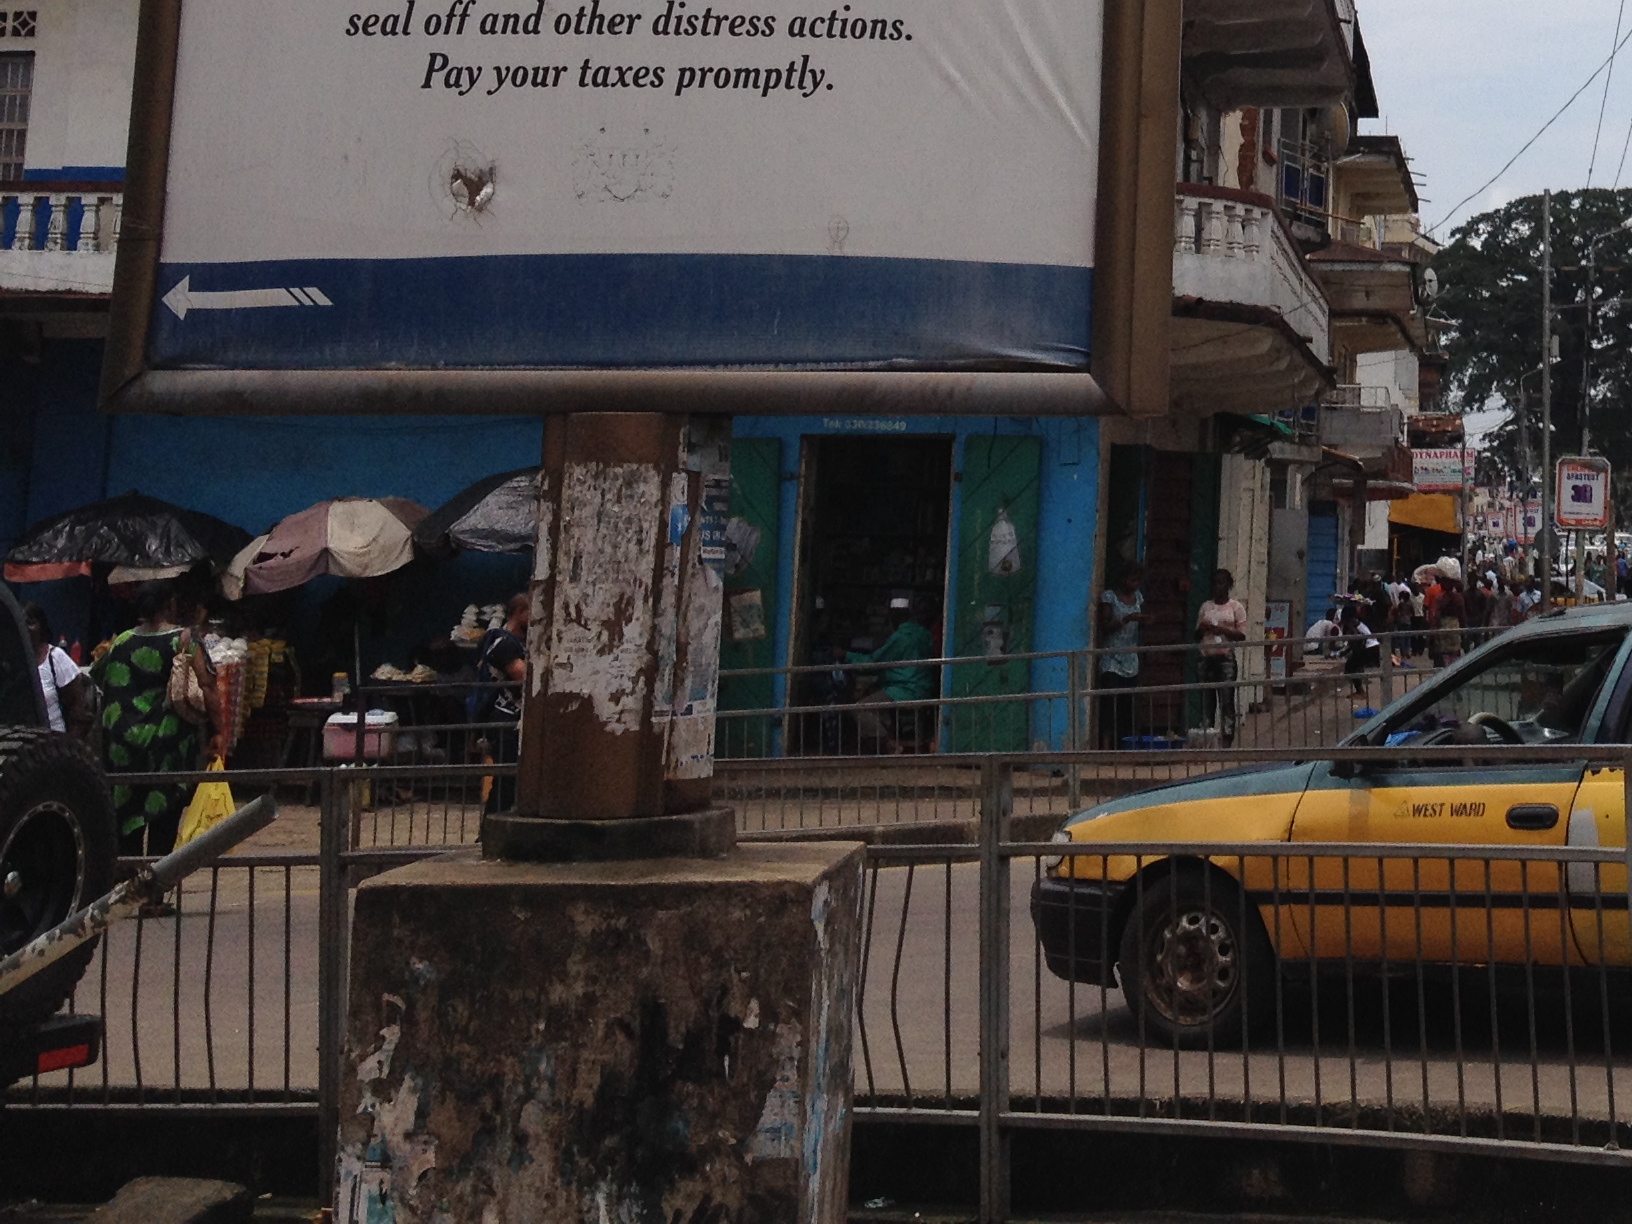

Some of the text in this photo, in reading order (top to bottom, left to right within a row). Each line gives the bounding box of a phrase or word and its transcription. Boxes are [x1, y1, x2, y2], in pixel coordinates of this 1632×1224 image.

[345, 0, 415, 37] seal
[479, 0, 544, 35] and
[554, 0, 641, 36] other
[651, 0, 776, 38] distress
[787, 4, 914, 41] actions.
[421, 52, 835, 97] Pay your taxes promptly.
[1414, 450, 1474, 460] DYNAPHAM
[1411, 801, 1486, 818] WEST WARD
